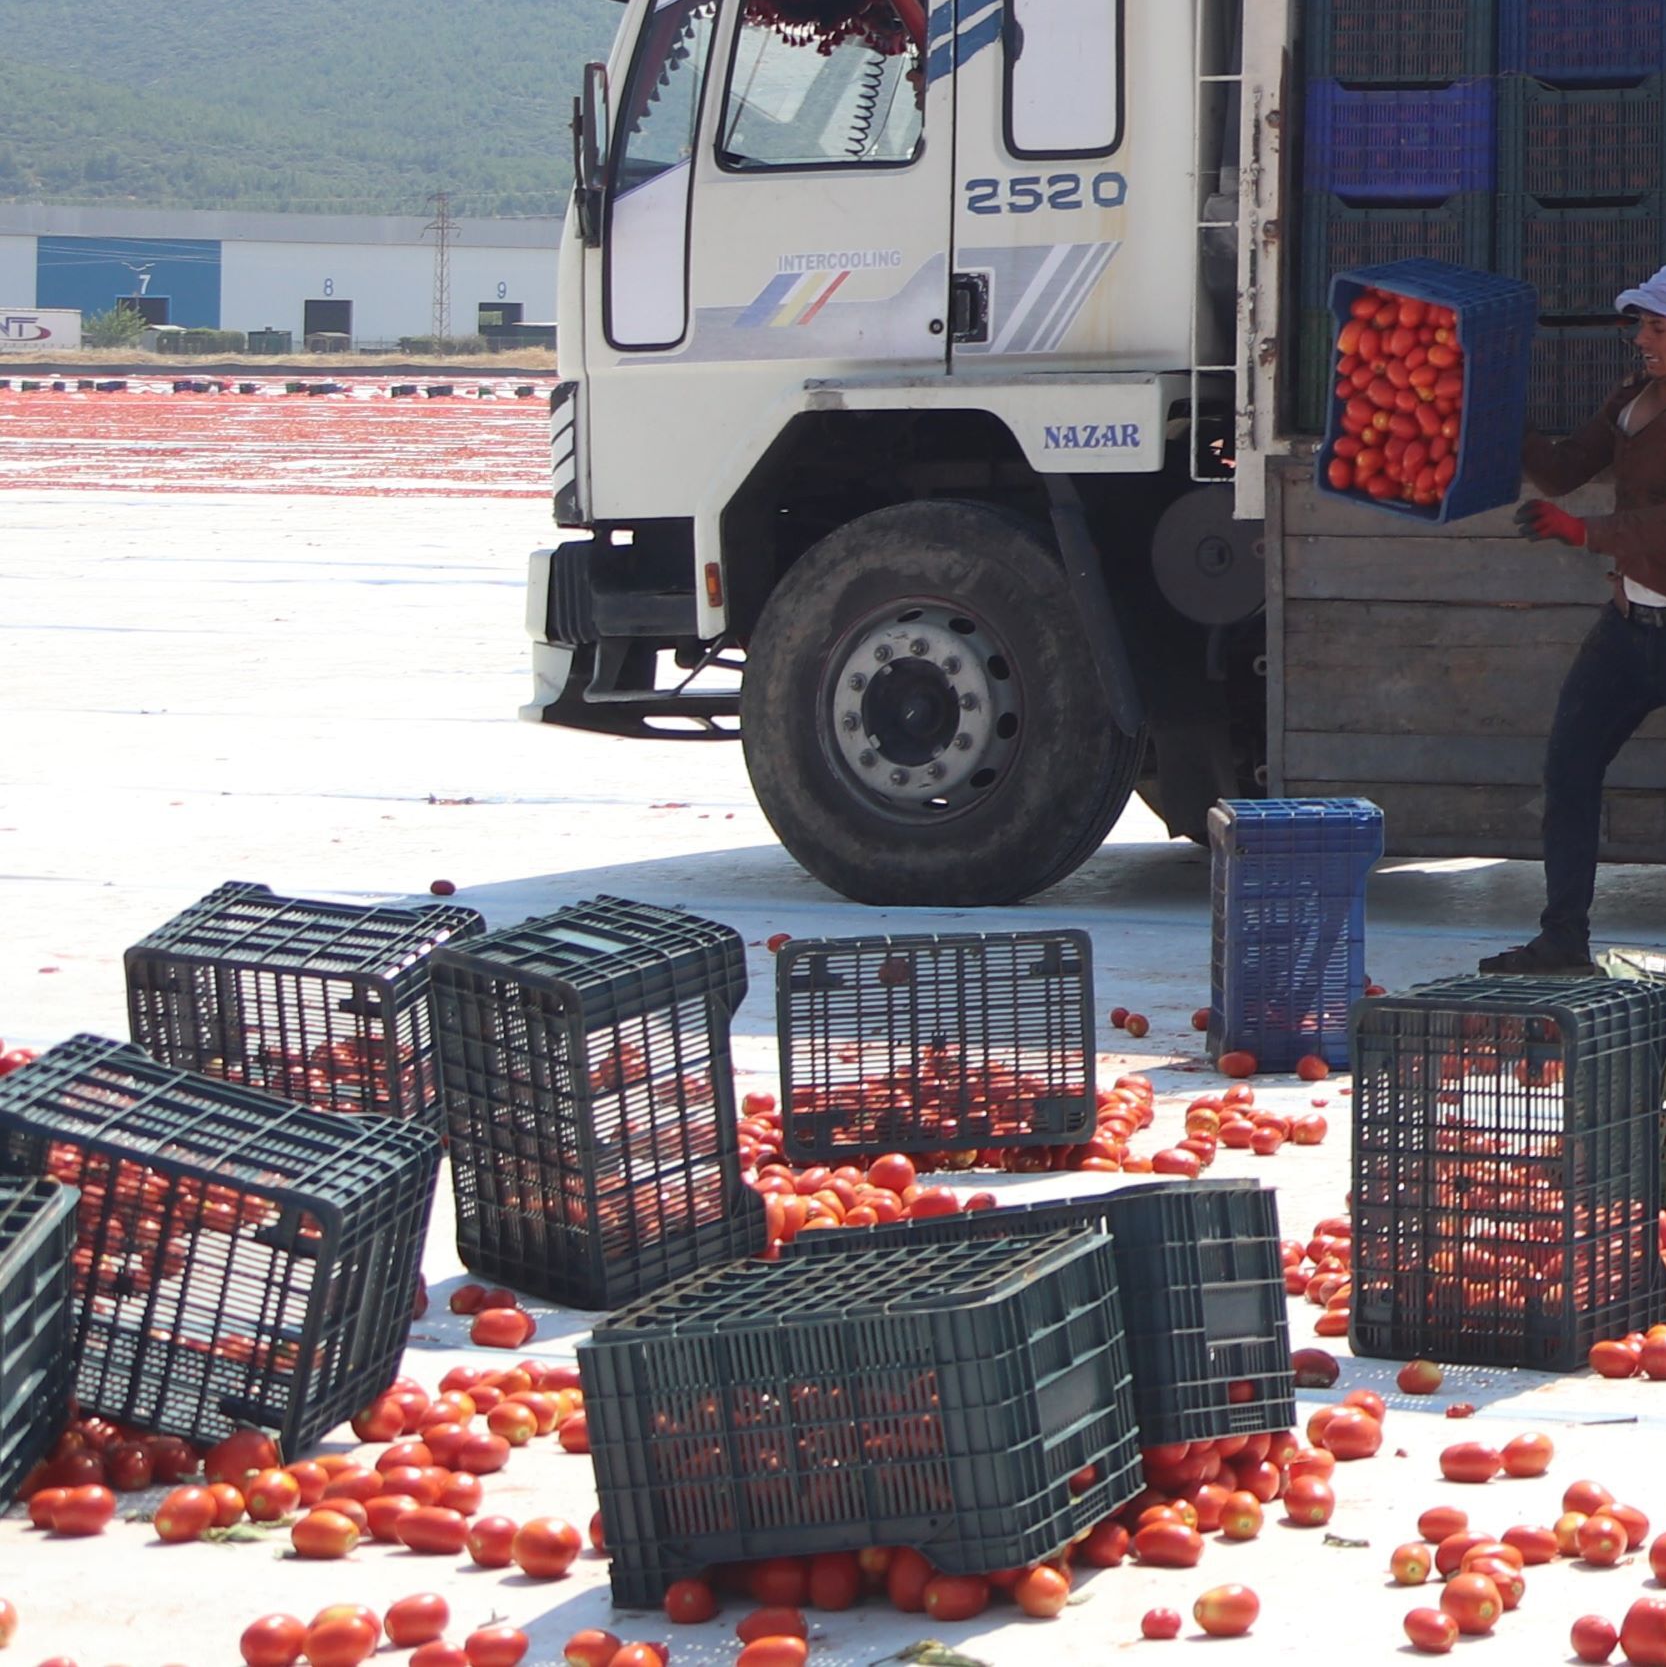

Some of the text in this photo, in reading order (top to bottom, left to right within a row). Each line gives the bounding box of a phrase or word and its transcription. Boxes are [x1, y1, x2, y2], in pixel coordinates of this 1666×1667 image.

[965, 172, 1128, 214] 2520
[778, 250, 900, 272] INTERCOOLING
[139, 274, 151, 295] 7
[324, 278, 334, 296] 8
[497, 281, 507, 299] 9
[1044, 423, 1140, 449] NAZAR
